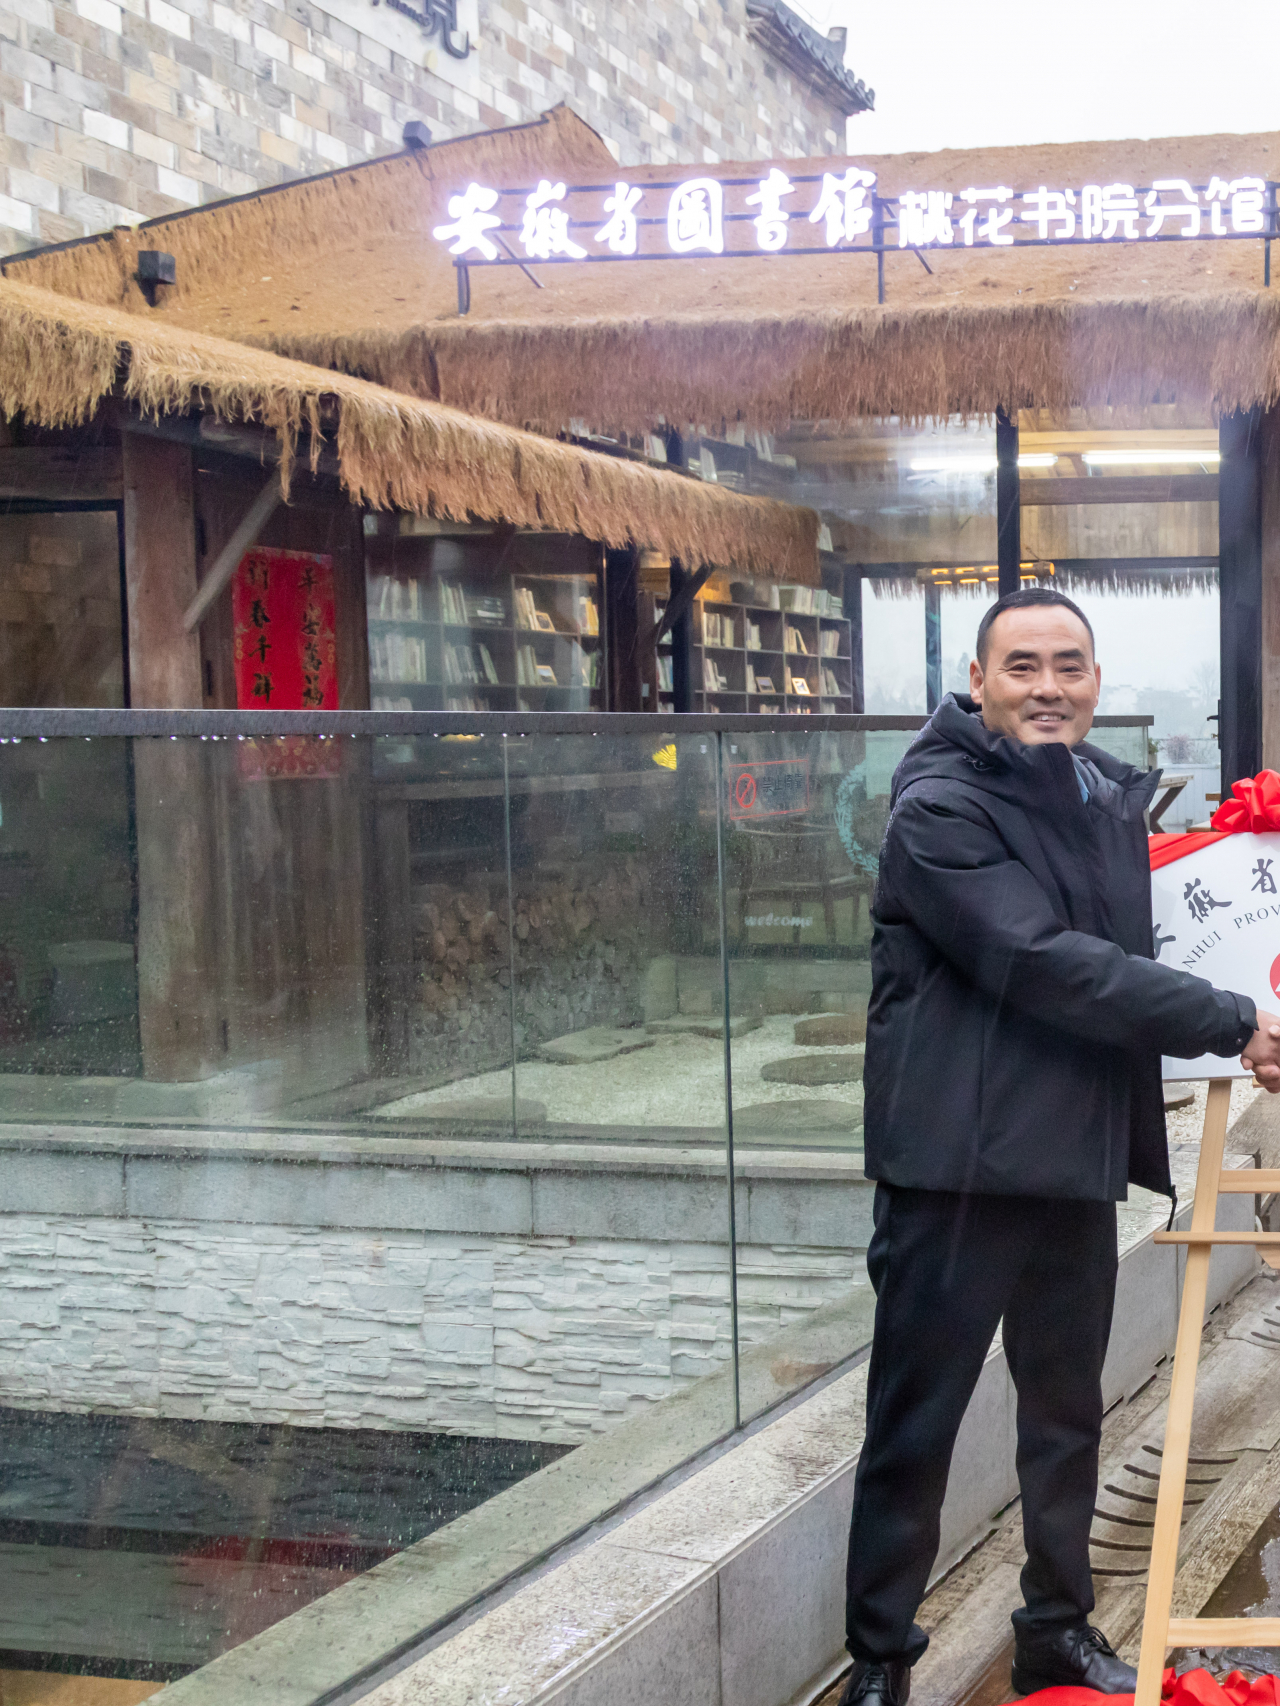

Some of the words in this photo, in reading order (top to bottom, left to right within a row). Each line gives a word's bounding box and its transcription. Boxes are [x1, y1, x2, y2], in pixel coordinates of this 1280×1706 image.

[898, 176, 1266, 248] 桃花书院分馆
[1181, 930, 1222, 970] NHUI
